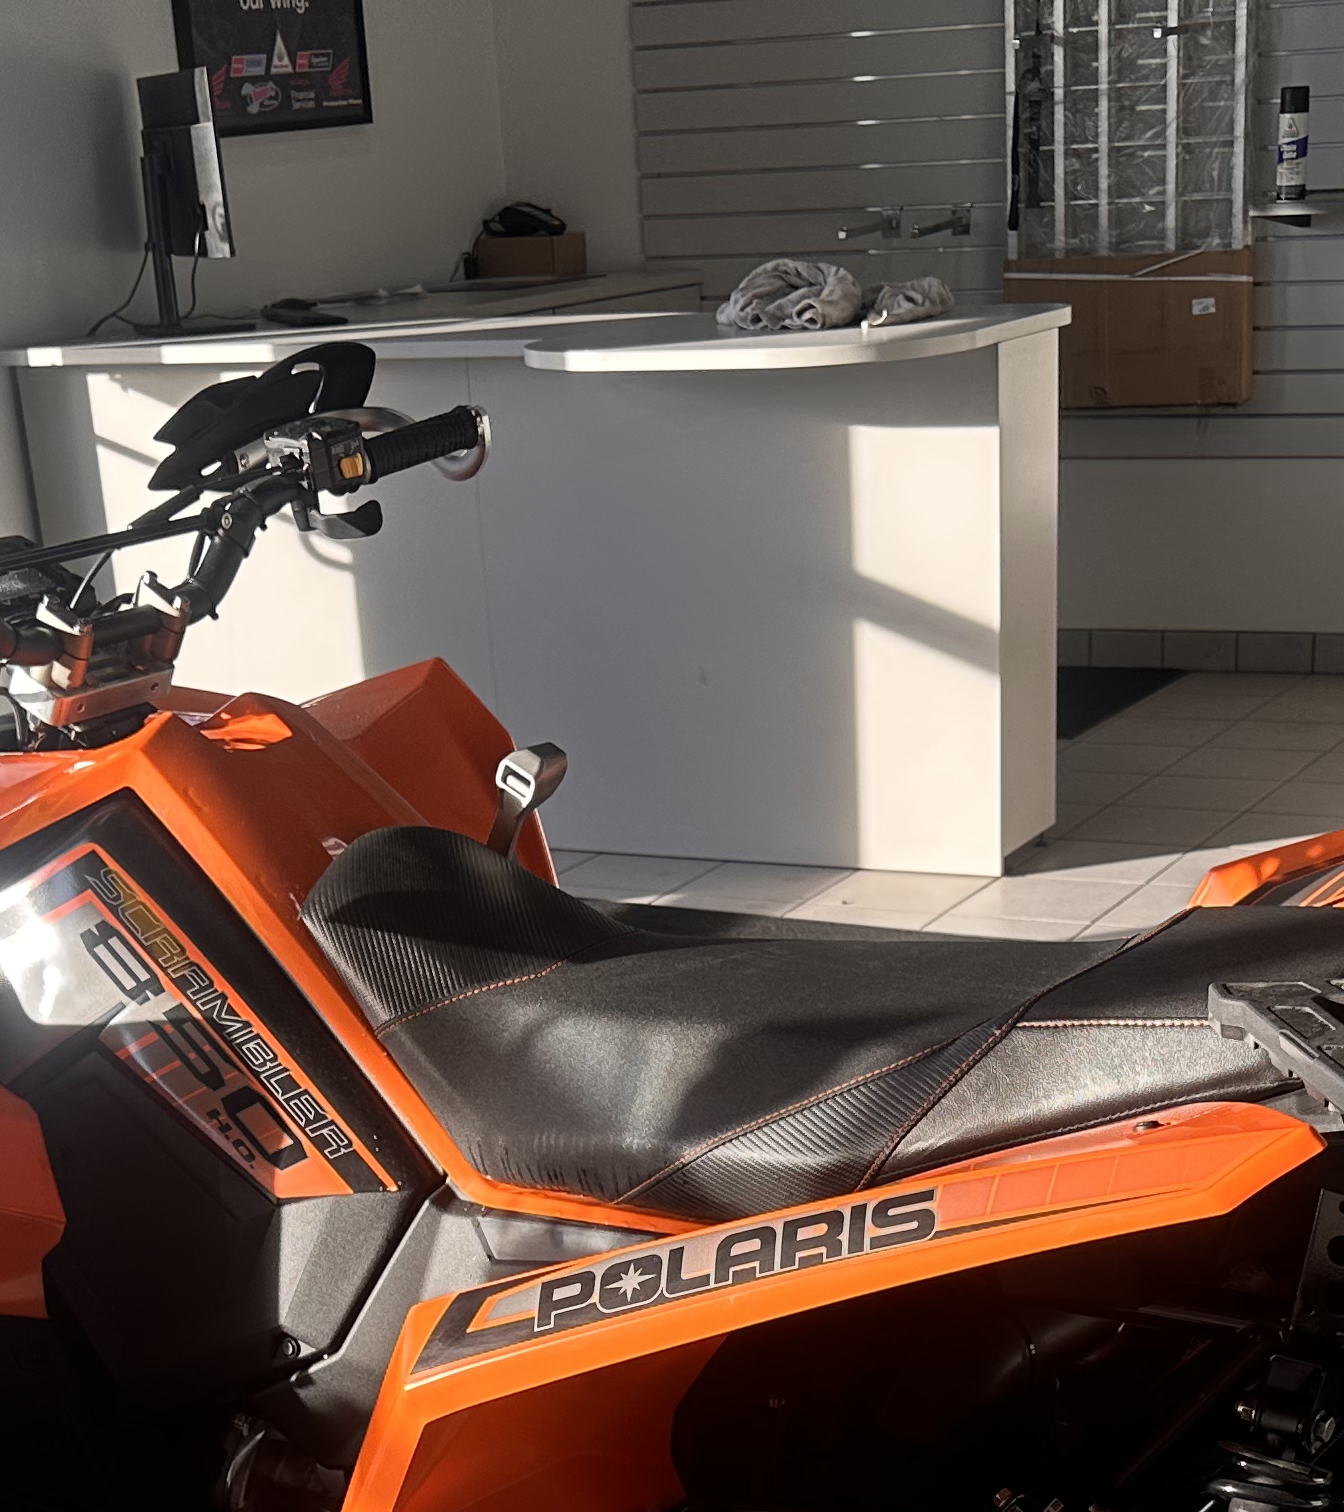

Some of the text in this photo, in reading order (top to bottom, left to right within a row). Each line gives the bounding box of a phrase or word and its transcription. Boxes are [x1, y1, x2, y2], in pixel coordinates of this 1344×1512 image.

[79, 918, 309, 1171] 850
[86, 867, 356, 1162] SCRAMBLER
[532, 1186, 938, 1332] POLARIS
